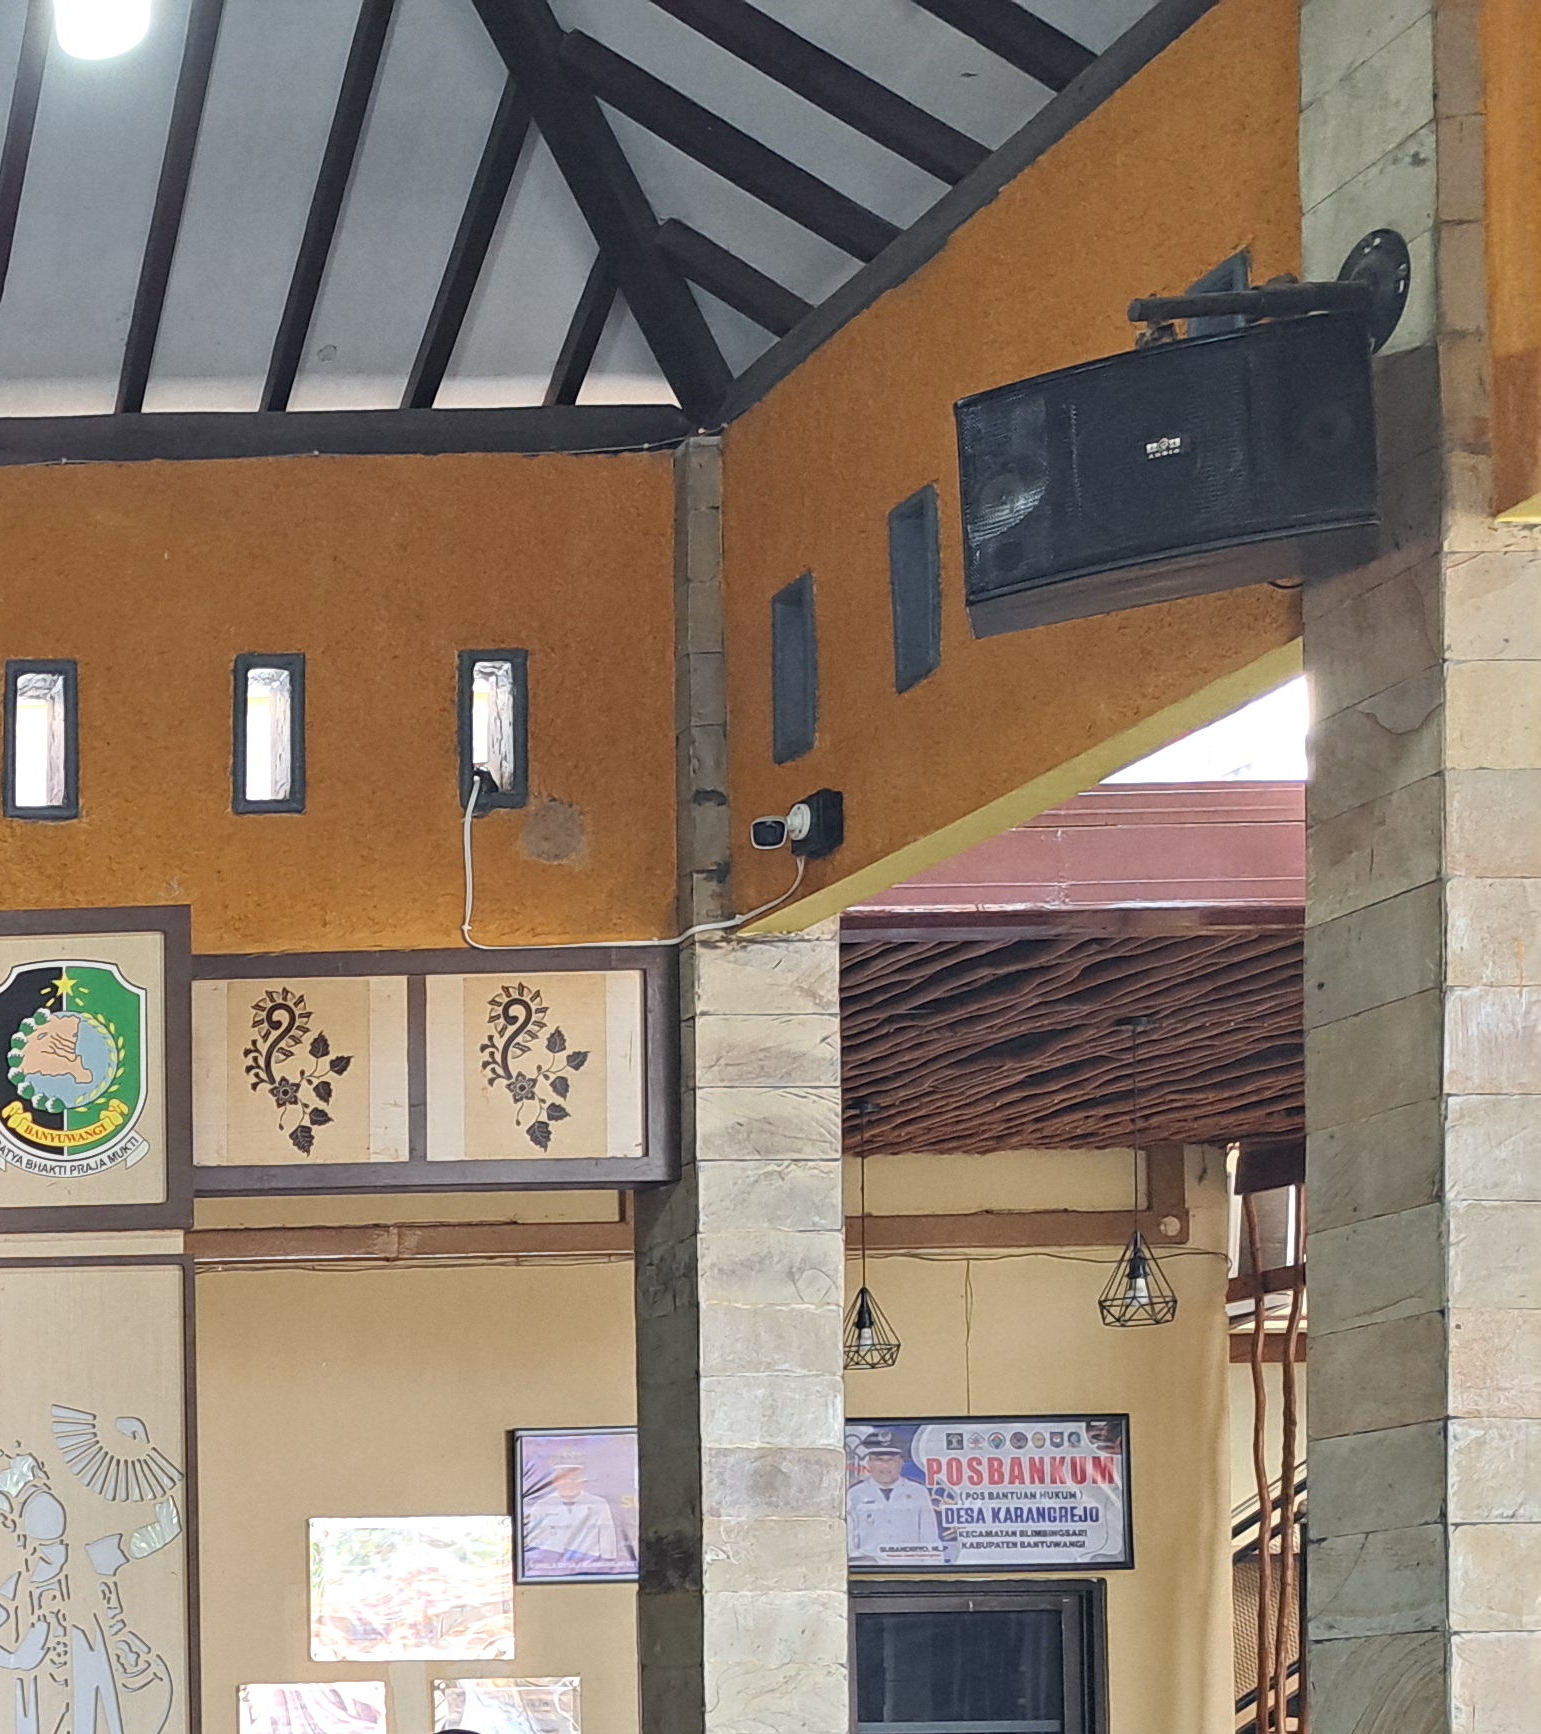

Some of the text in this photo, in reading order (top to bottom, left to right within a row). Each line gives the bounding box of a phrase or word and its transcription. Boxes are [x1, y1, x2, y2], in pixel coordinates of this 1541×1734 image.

[23, 1123, 107, 1144] BANYUWANGI
[24, 1160, 67, 1175] BHAKTI
[69, 1160, 107, 1175] PRAJA
[106, 1138, 140, 1164] MUKTI
[926, 1455, 1116, 1486] POSBANKUM
[988, 1491, 1036, 1501] BANTUAN
[945, 1506, 1100, 1524] DESA KARANGREJO
[959, 1529, 1017, 1538] KECAMATAN
[961, 1541, 1018, 1549] KABUPATEN
